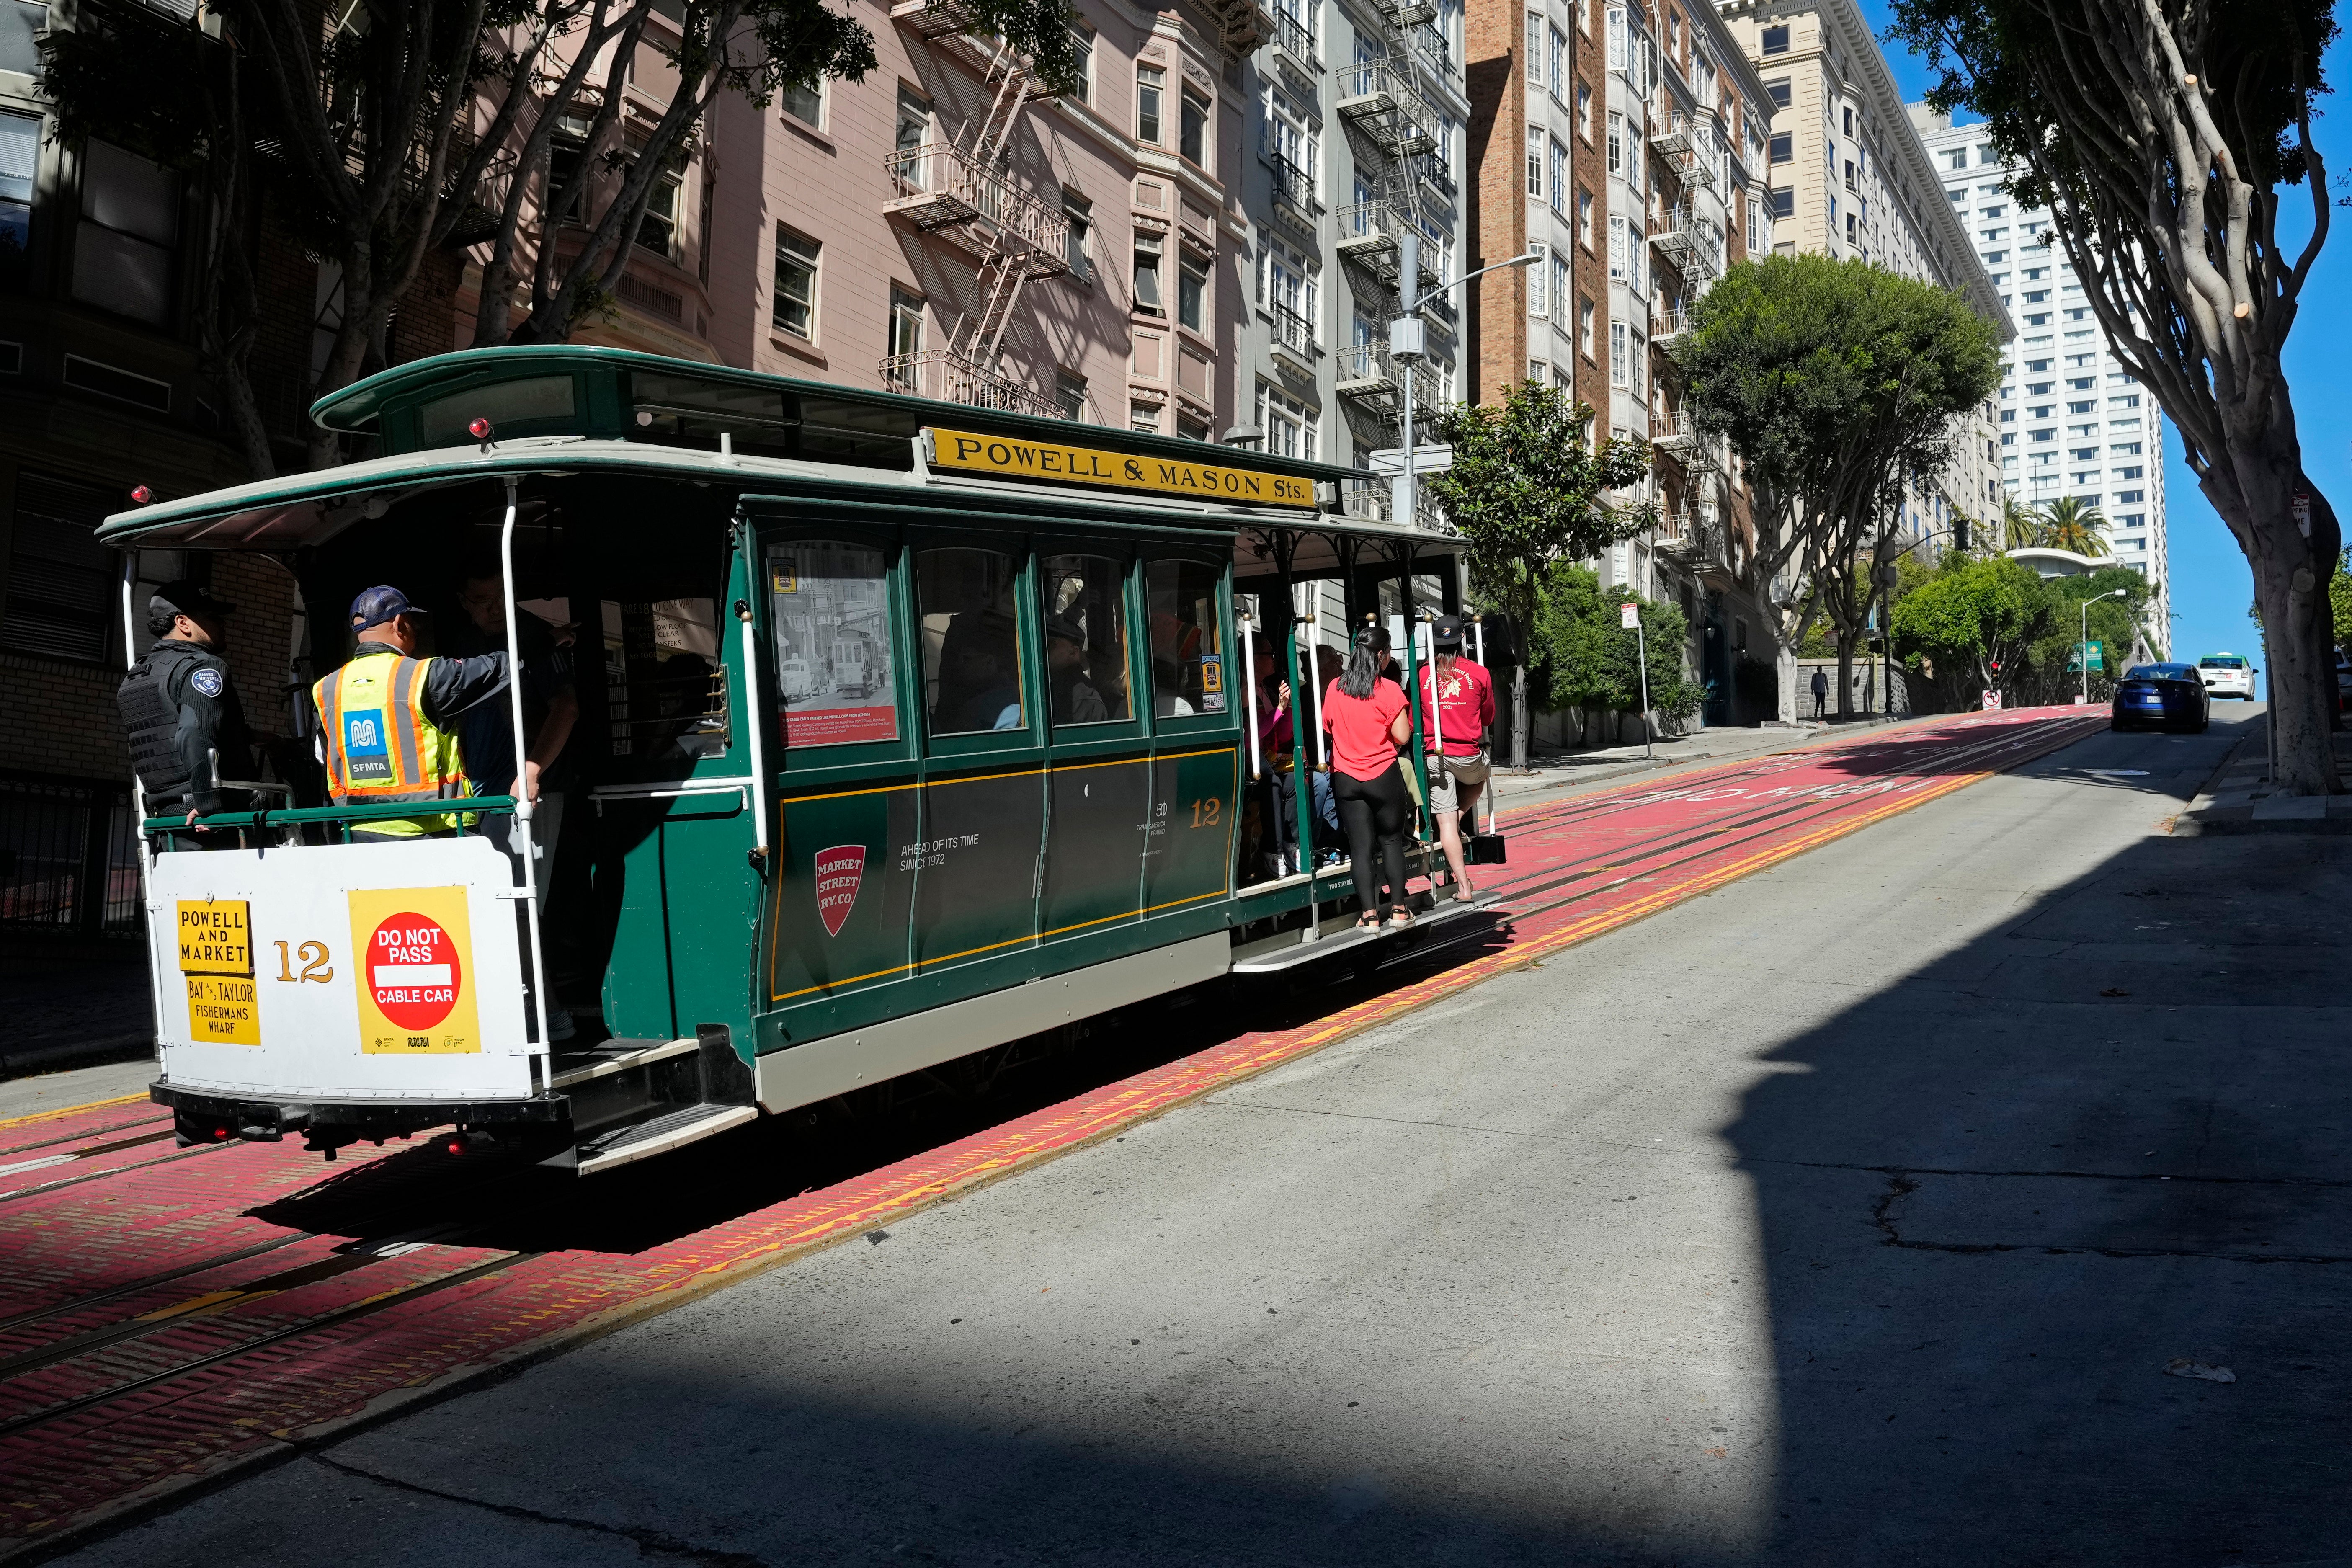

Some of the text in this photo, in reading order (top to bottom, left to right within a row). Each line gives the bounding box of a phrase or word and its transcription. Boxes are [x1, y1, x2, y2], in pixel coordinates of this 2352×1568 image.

[955, 438, 1305, 500] POWELL & MASON Sts.
[663, 600, 678, 611] ONE
[679, 598, 693, 609] WAY
[645, 640, 681, 649] TRANSFERS
[1464, 673, 1474, 690] Festival
[353, 763, 386, 772] SFMTA
[1190, 797, 1220, 829] 12
[901, 833, 979, 856] AHEAD OF ITS TIME
[818, 859, 861, 877] MARKET
[900, 854, 944, 871] SINCE 1972
[819, 876, 858, 893] STREET
[181, 911, 243, 929] POWELL
[198, 930, 228, 942] AND
[378, 928, 441, 946] DO NOT
[181, 944, 245, 962] MARKET
[389, 946, 432, 963] PASS
[273, 941, 333, 983] 12
[189, 980, 253, 1003] BAY AND TAYLOR
[377, 989, 453, 1003] CABLE CAR
[196, 1006, 248, 1020] FISHERMANS
[208, 1022, 235, 1034] WHARF
